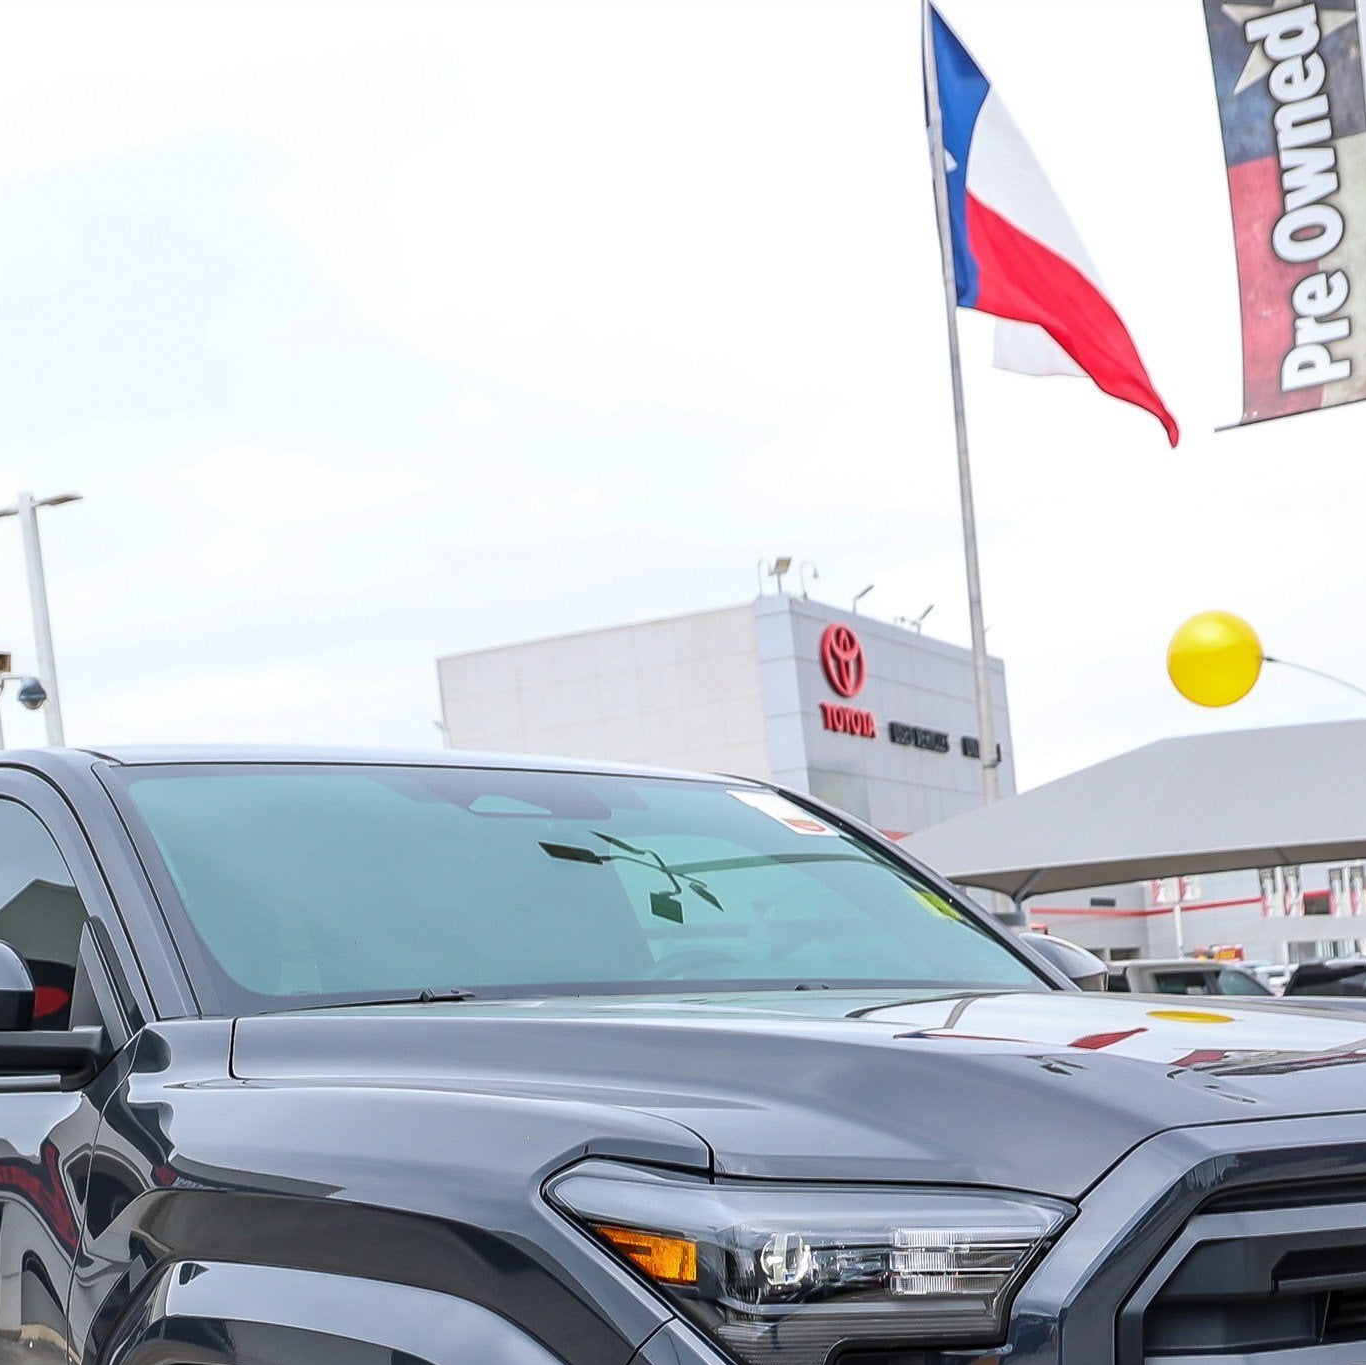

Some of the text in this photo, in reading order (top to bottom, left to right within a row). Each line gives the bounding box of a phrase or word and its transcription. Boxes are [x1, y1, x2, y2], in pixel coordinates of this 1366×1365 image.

[1245, 2, 1352, 391] Pre Owned
[819, 701, 878, 739] TOYOTA
